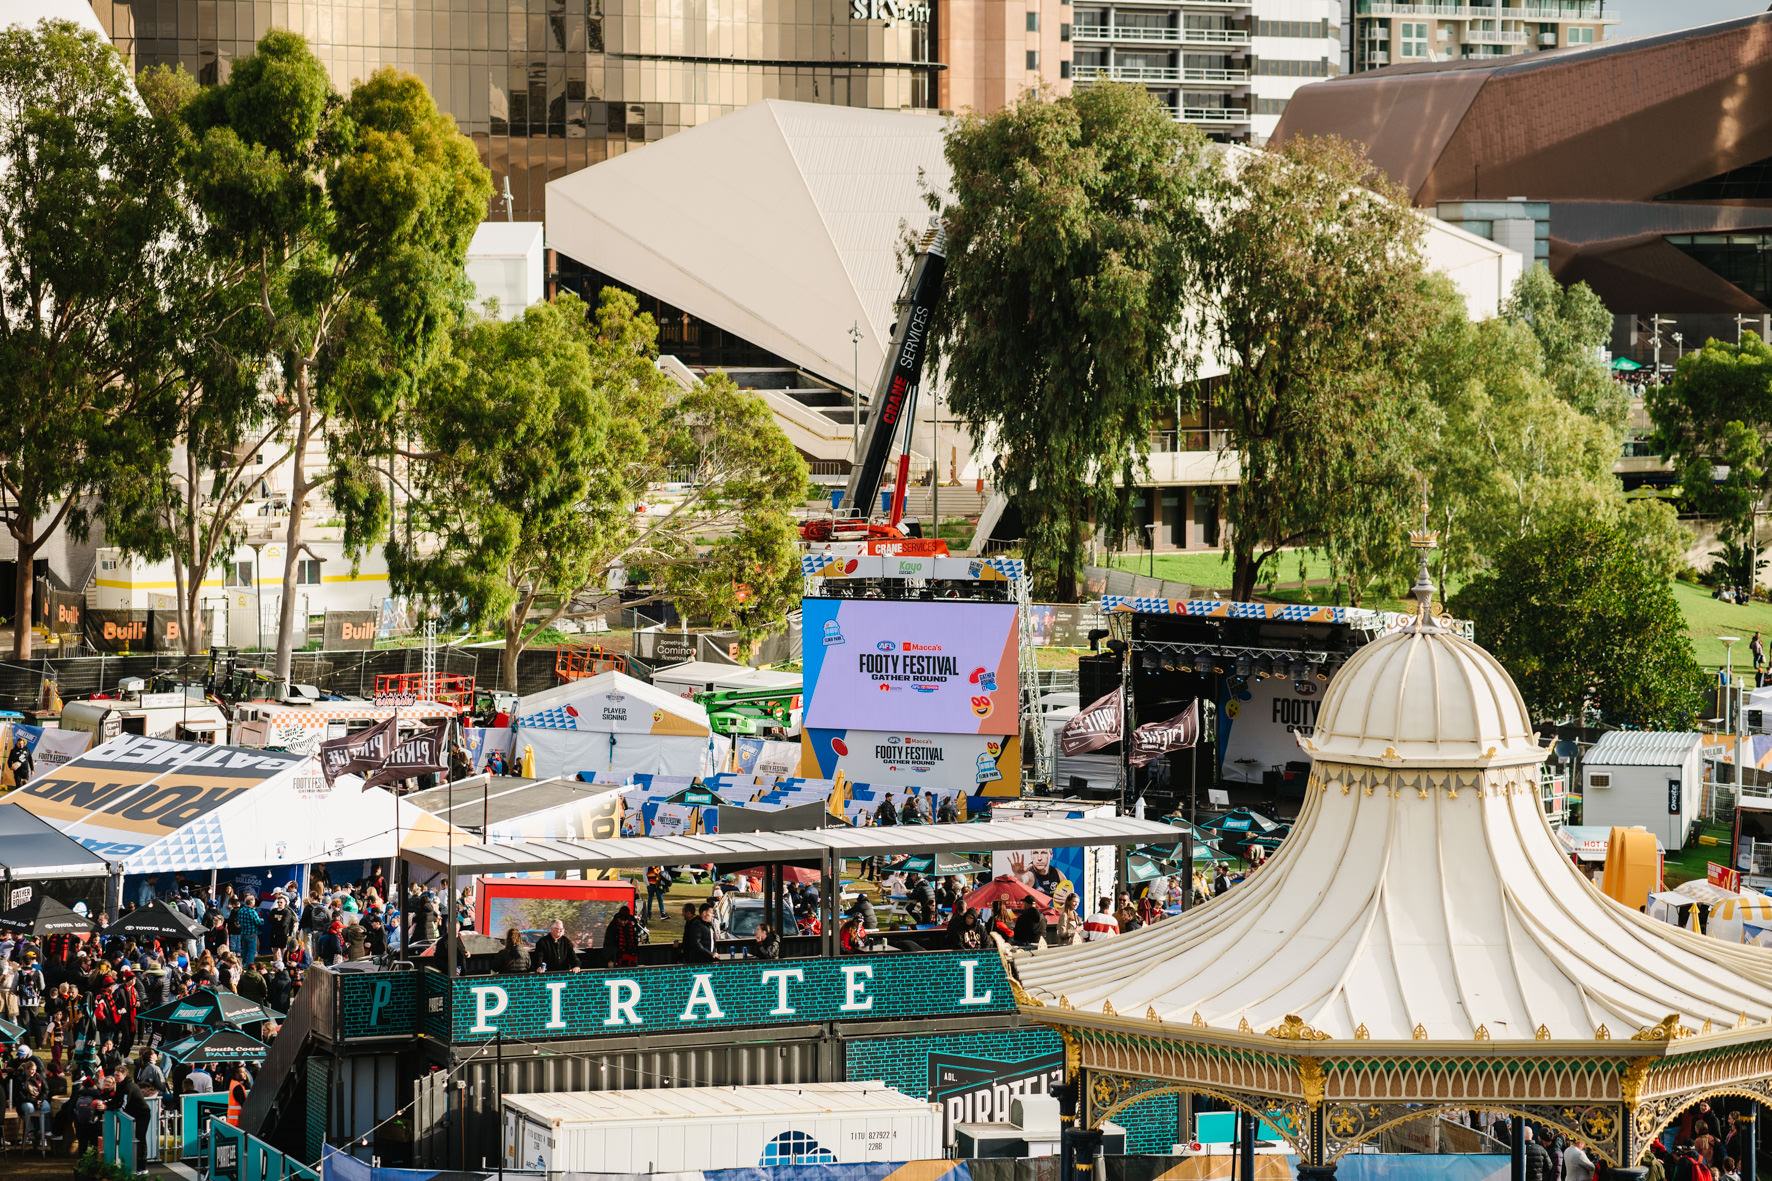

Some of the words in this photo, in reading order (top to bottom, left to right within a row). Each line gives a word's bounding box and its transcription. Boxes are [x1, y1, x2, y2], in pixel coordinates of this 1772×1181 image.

[883, 375, 907, 425] CRANE
[900, 305, 928, 369] SERVICES
[899, 561, 923, 574] Kayo
[58, 604, 80, 624] Built
[104, 621, 148, 641] Built
[879, 642, 894, 650] AFL
[912, 643, 942, 652] Macca's
[859, 653, 900, 673] FOOTY
[902, 655, 959, 676] FESTIVAL
[871, 673, 911, 682] GATHER
[912, 675, 948, 683] ROUND
[1297, 682, 1316, 693] AFL
[602, 713, 627, 721] SIGNING
[603, 707, 627, 715] PLAYER
[1272, 697, 1322, 726] FOOTY
[38, 752, 53, 760] FOOTY
[80, 733, 300, 771] GATHER
[875, 745, 903, 759] FOOTY
[905, 746, 944, 762] FESTIVAL
[293, 777, 312, 790] FOOTY
[21, 779, 249, 829] ROUND
[1670, 784, 1679, 811] Onsite
[12, 888, 31, 899] GATHER
[470, 965, 873, 1033] PIRATE
[943, 1072, 958, 1082] ADL.
[850, 1132, 865, 1141] TITU
[868, 1130, 890, 1140] 827922
[892, 1130, 897, 1138] 4
